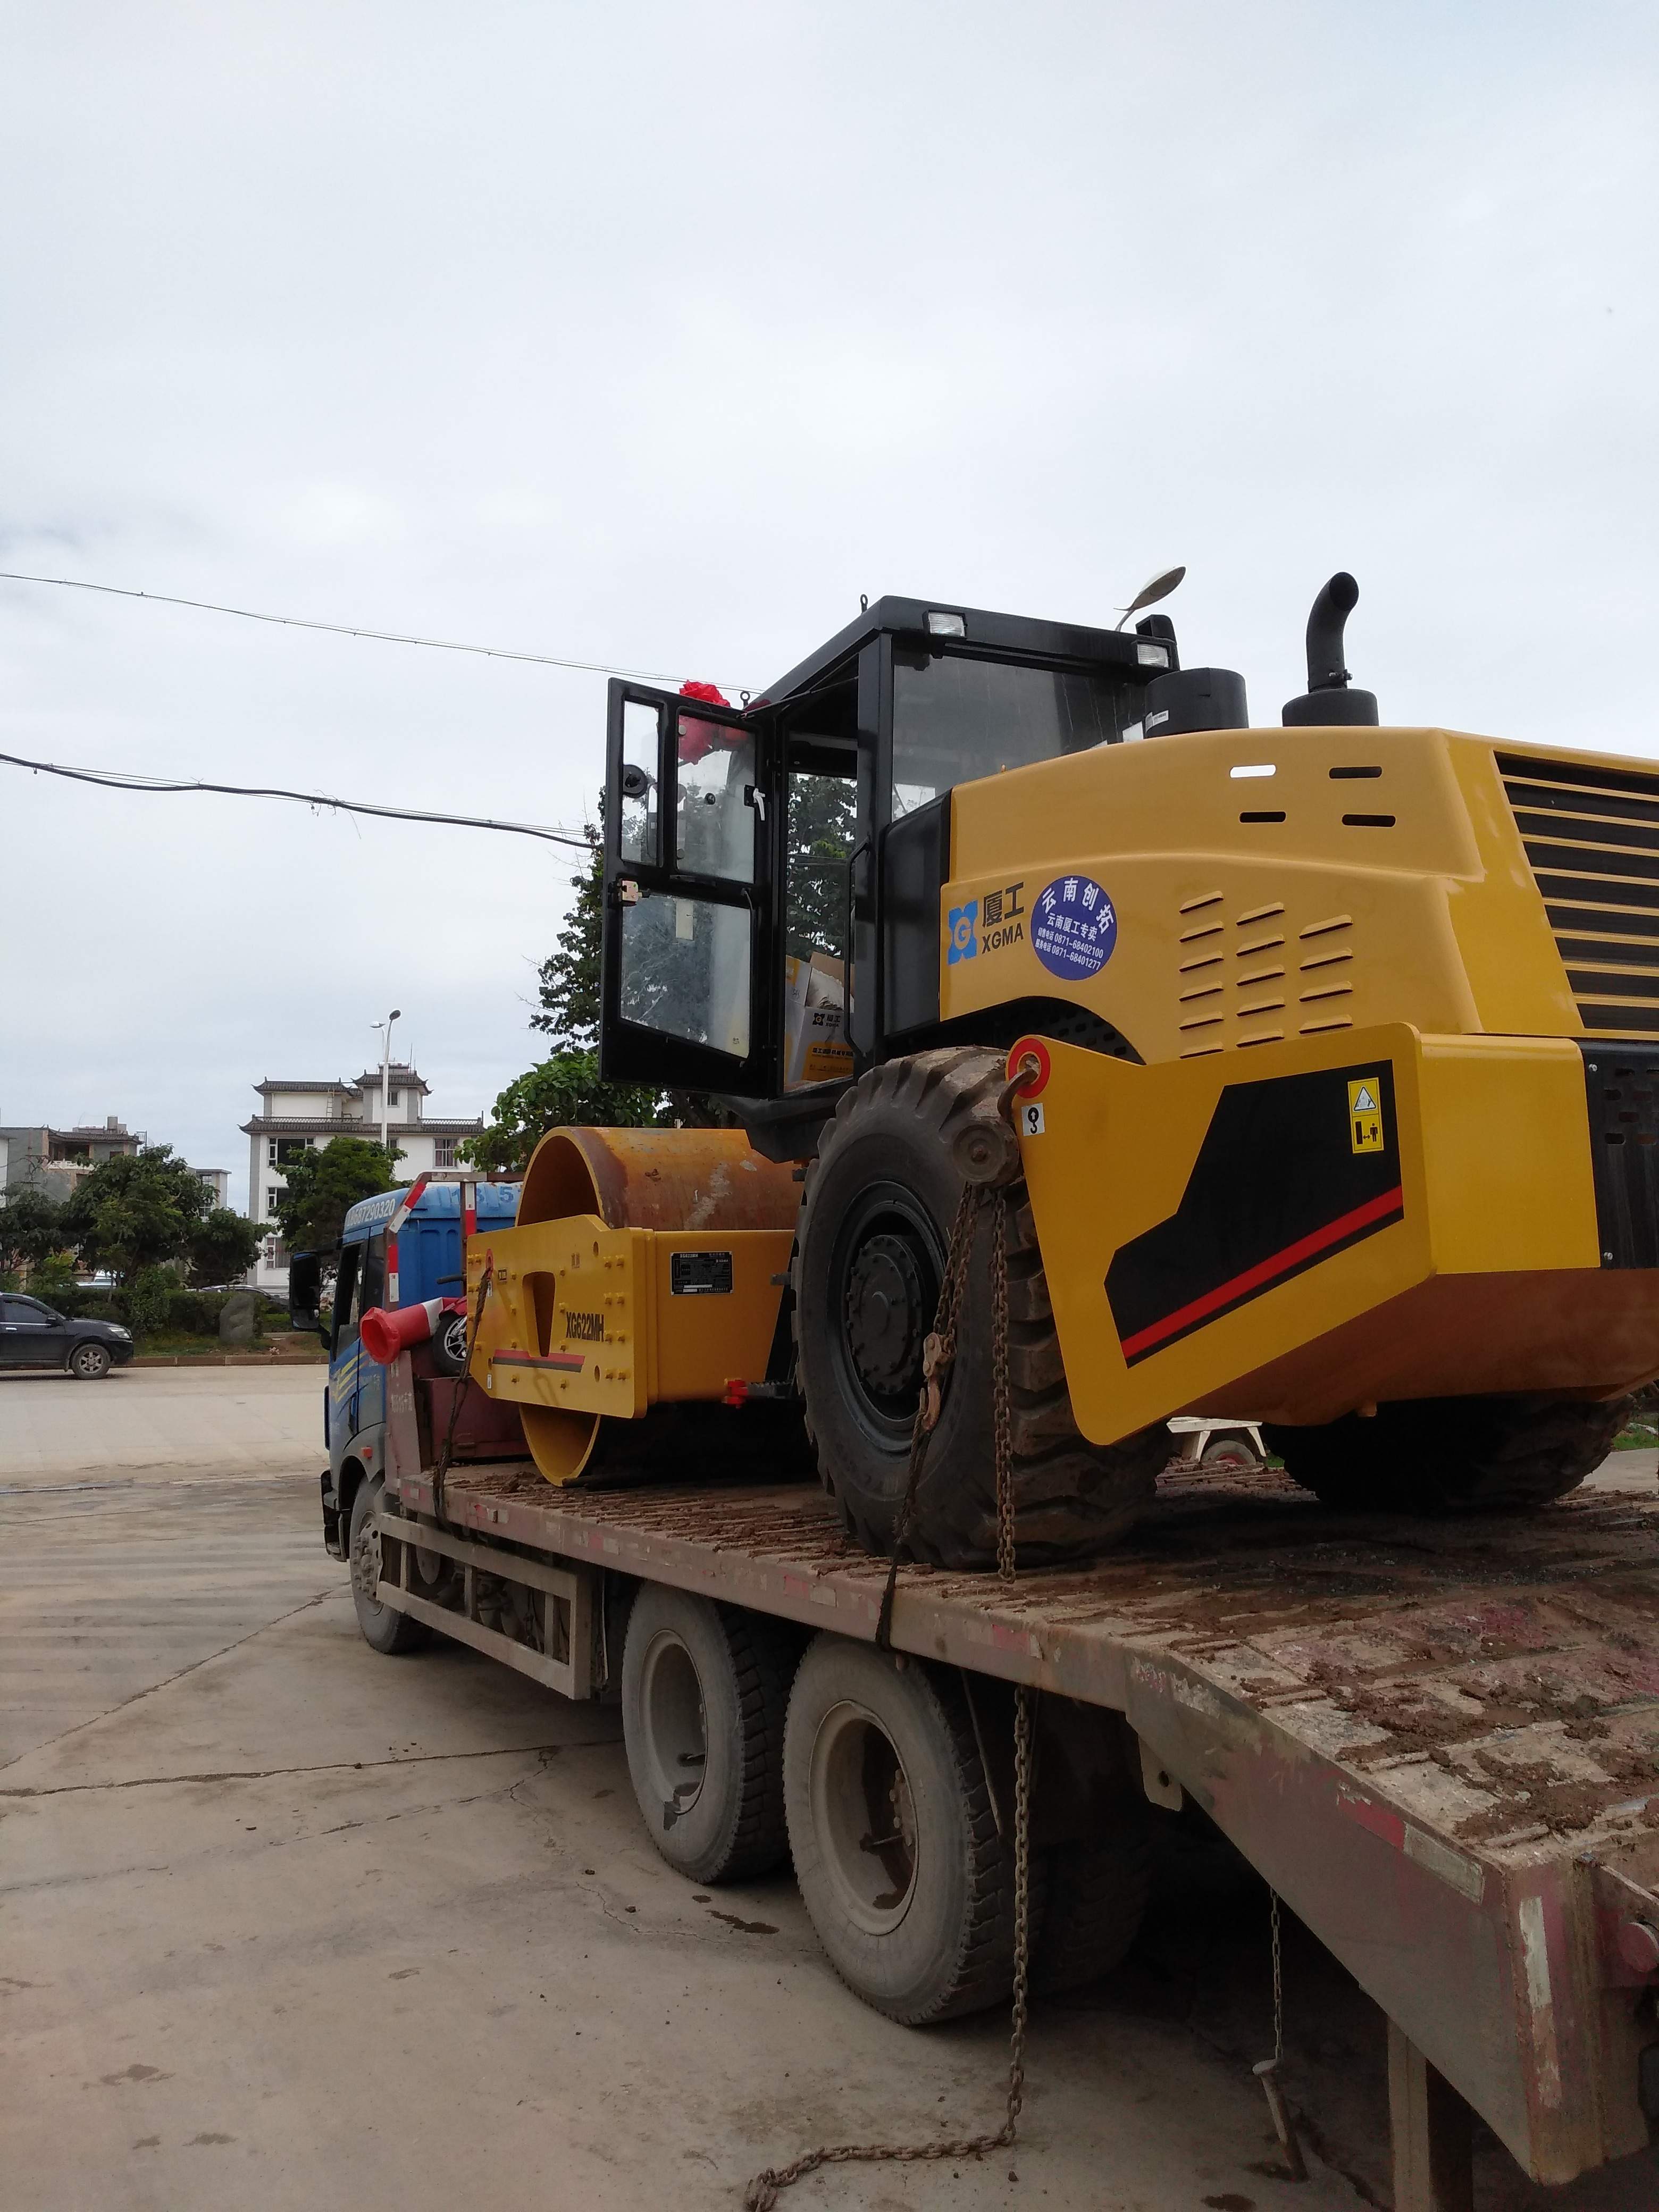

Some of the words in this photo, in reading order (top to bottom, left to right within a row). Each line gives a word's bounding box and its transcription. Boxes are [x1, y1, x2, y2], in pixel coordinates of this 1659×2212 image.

[982, 882, 1024, 927] 厦工
[1042, 878, 1114, 934] 云南创拓
[982, 923, 1024, 954] XGMA
[1037, 926, 1054, 941] 销售电话
[1054, 933, 1104, 959] 0871-68402100
[1047, 912, 1098, 942] 云南厦工专卖
[1035, 938, 1052, 952] 服务电话
[1051, 945, 1101, 970] 0871-68401277
[566, 1312, 604, 1342] XG622MH
